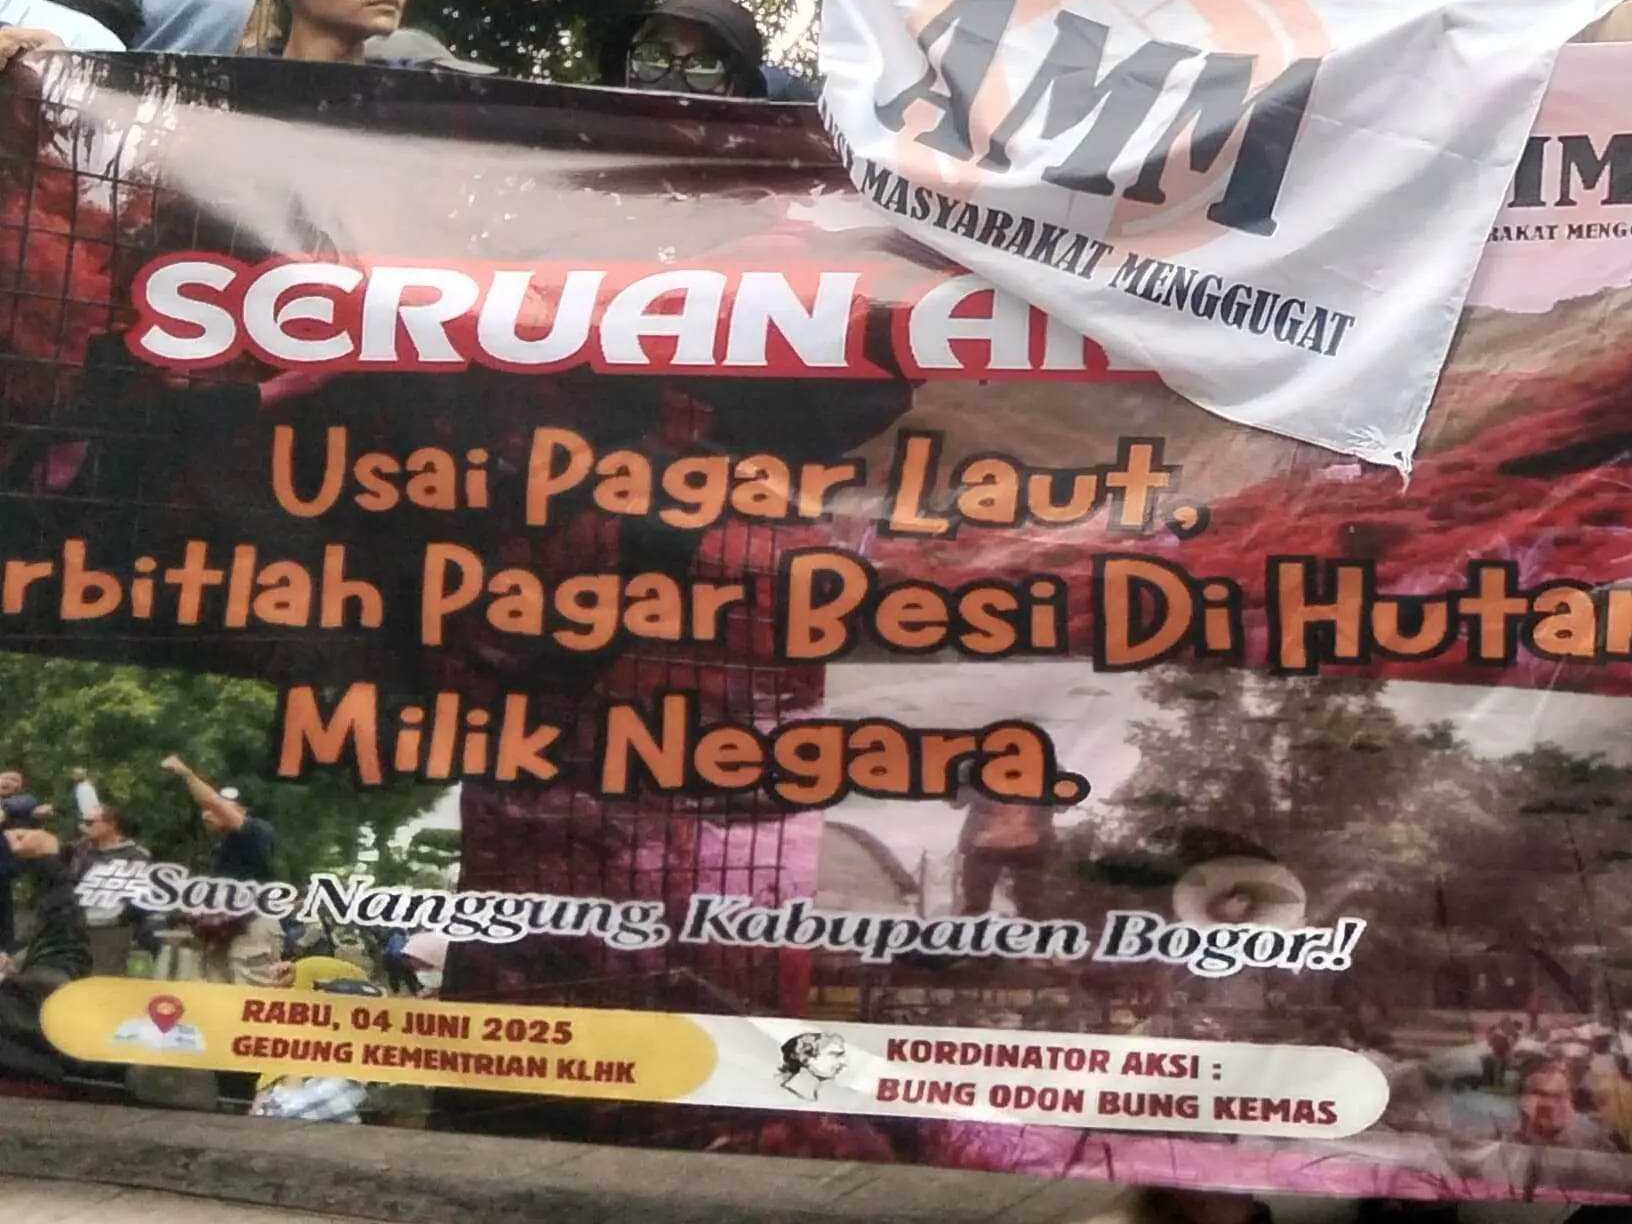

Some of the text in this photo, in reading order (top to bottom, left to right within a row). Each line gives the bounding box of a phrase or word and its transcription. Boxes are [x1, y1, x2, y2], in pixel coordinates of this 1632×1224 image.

[861, 159, 1355, 357] MASYARAKAT MENGGUGAT
[138, 261, 862, 368] SERUAN
[272, 425, 492, 518] Usai
[526, 426, 857, 529] Pagar
[2, 539, 383, 629] rbitlah
[422, 542, 745, 651] Pagar
[785, 553, 1058, 660] Besi
[1103, 558, 1242, 666] Di
[277, 681, 1090, 804] Milik Negara.
[75, 859, 295, 918] #Save
[301, 873, 669, 948] Nanggung,
[683, 893, 1086, 961] Kabupaten
[231, 1035, 637, 1085] GEDUNG KEMENTRIAN KLHK
[241, 999, 573, 1045] RABU, 04 JUNI 2025
[886, 1038, 1111, 1074] KORDINATOR
[1122, 1050, 1199, 1079] AKSI
[875, 1077, 1337, 1126] BUNG ODON BUNG KEMAS
